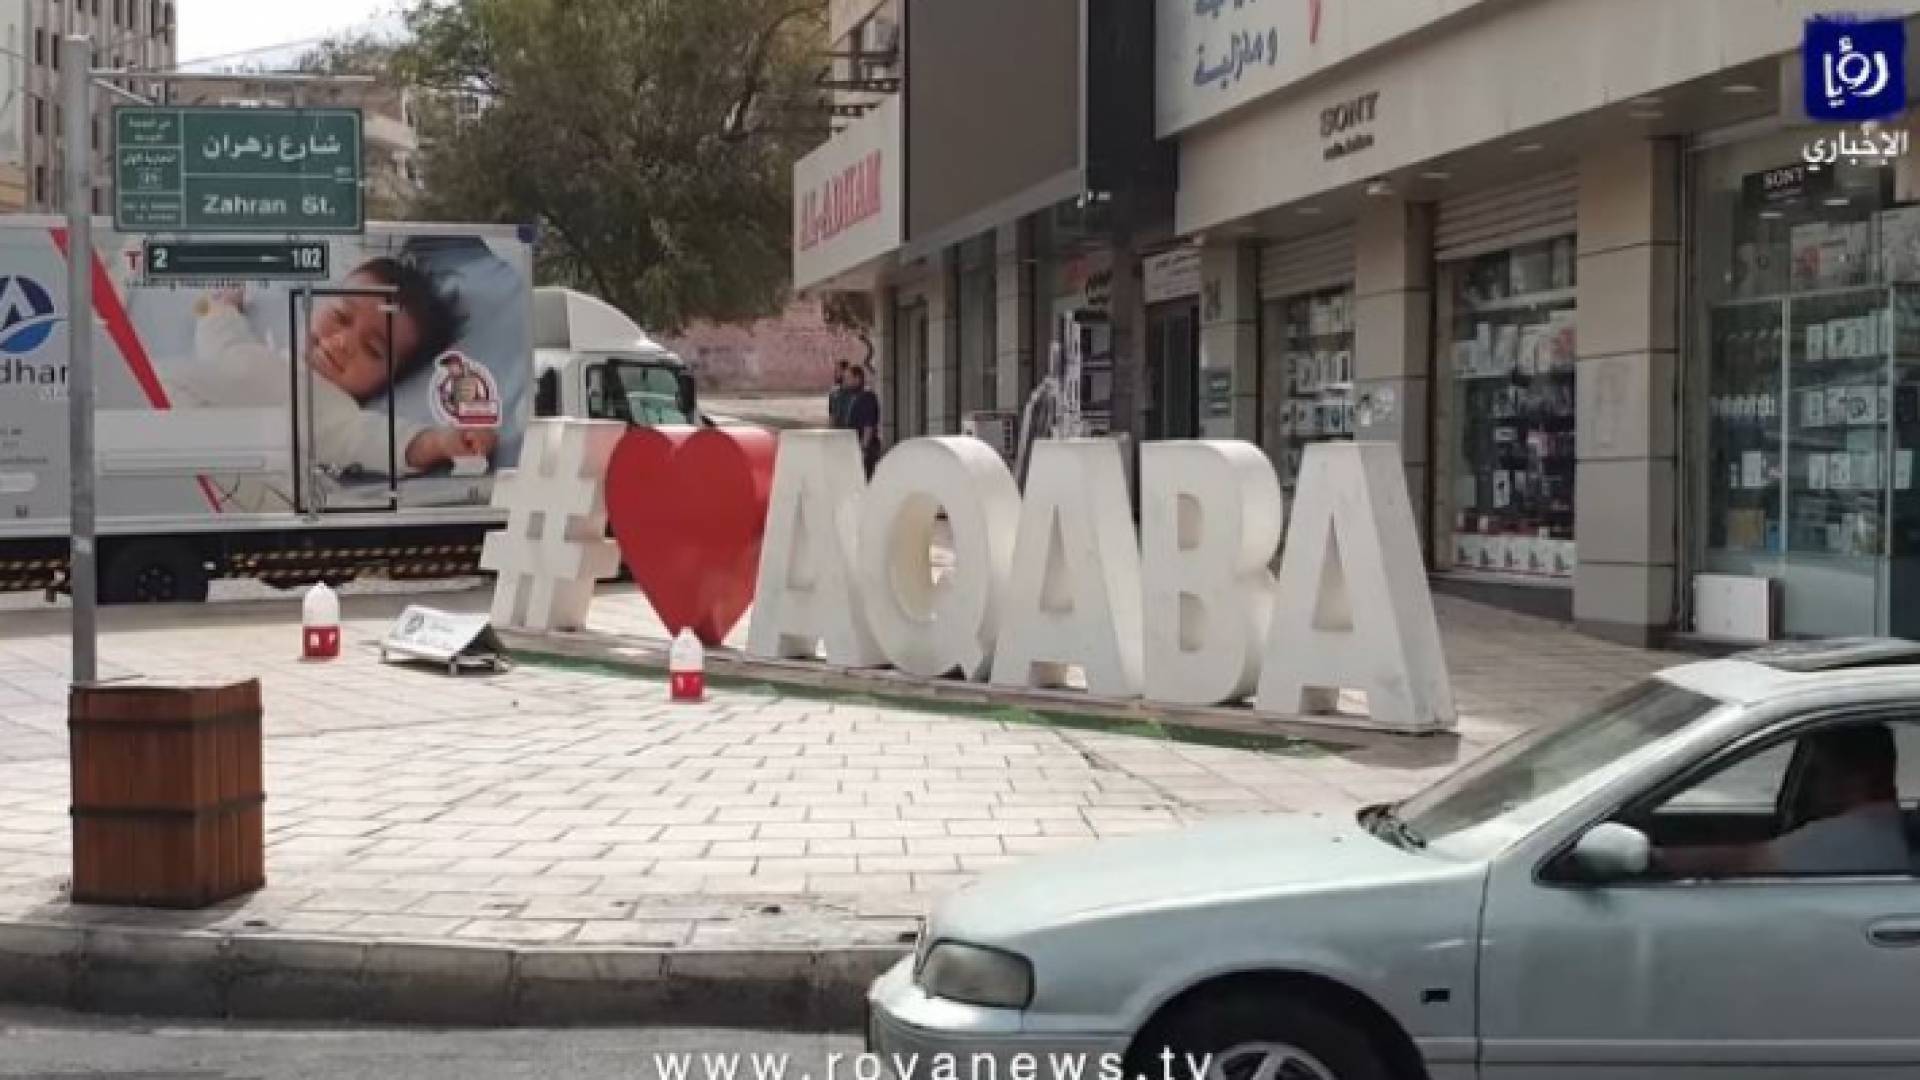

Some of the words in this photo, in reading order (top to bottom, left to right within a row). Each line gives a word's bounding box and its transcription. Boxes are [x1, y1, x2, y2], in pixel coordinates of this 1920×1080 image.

[1320, 91, 1380, 137] SONY
[202, 134, 274, 160] زهران
[278, 134, 341, 162] شارع
[203, 193, 287, 216] Zahran
[302, 193, 336, 216] St.
[153, 248, 168, 268] 2
[291, 248, 322, 269] 102
[747, 428, 1458, 733] AQABA
